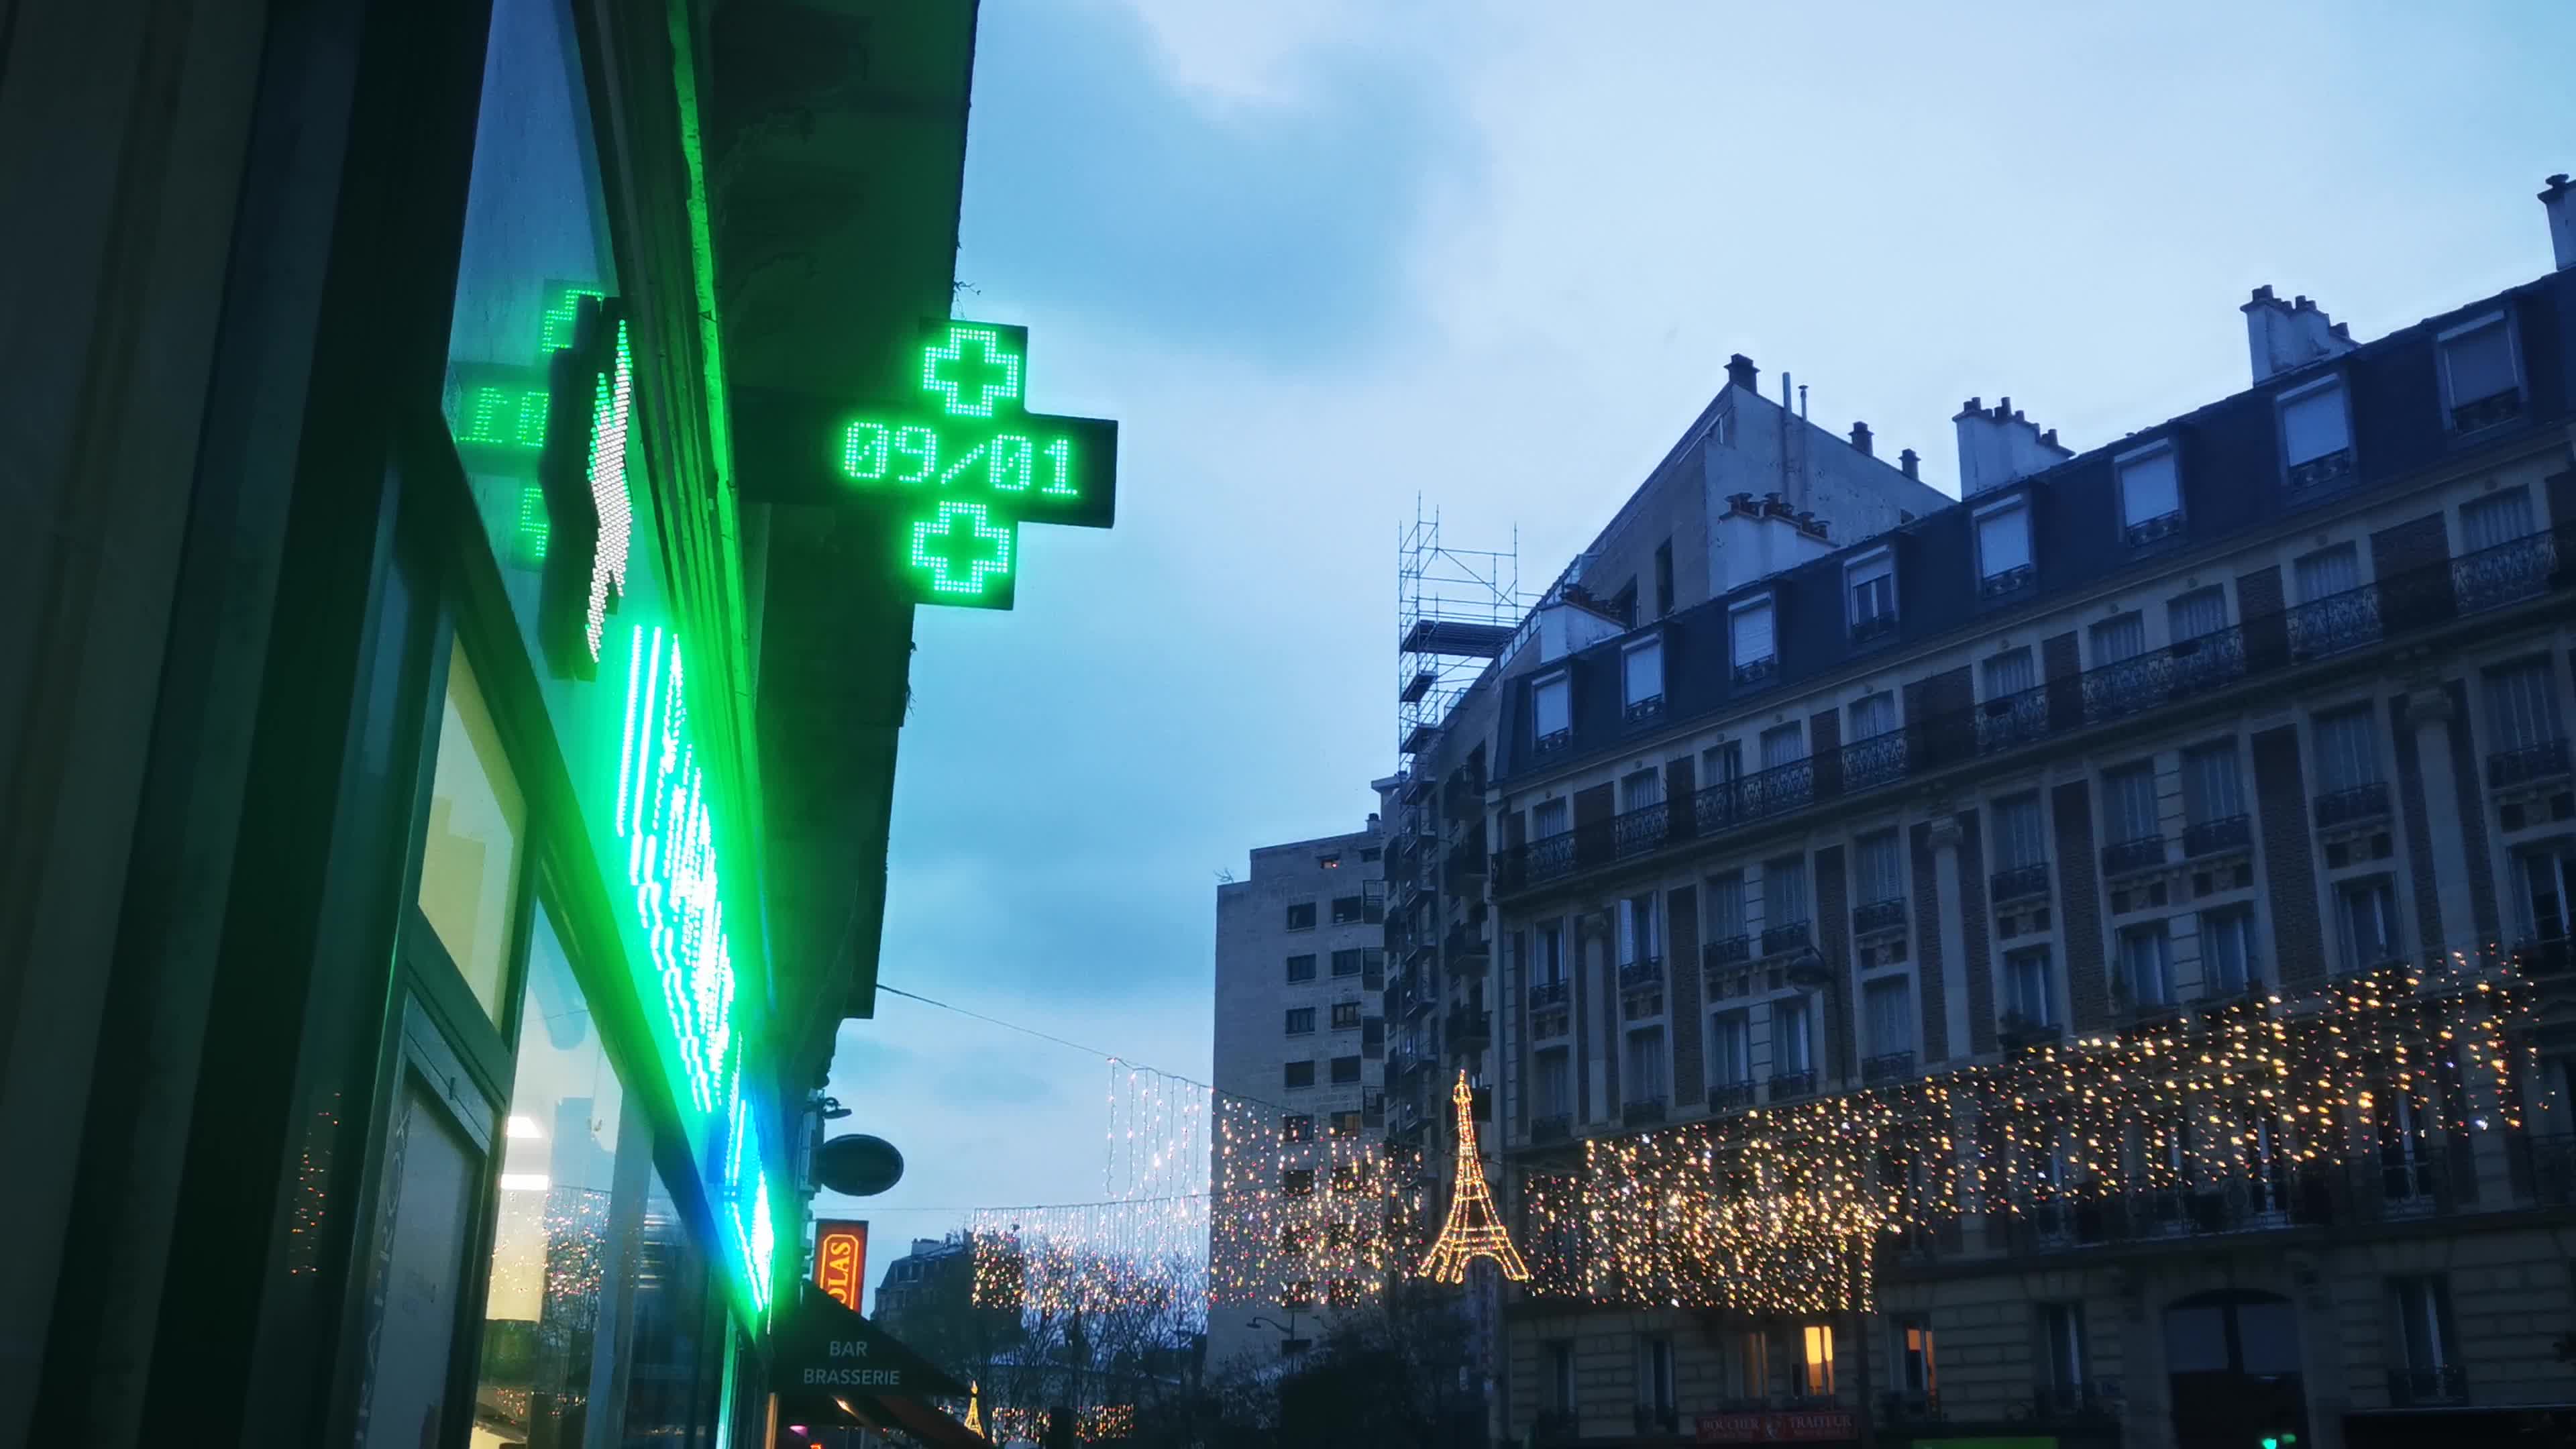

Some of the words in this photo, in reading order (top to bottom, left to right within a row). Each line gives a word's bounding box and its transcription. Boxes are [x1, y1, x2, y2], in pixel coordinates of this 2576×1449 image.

[843, 421, 1079, 496] 09/01
[829, 1341, 869, 1358] BAR
[804, 1368, 901, 1385] BRASSERIE
